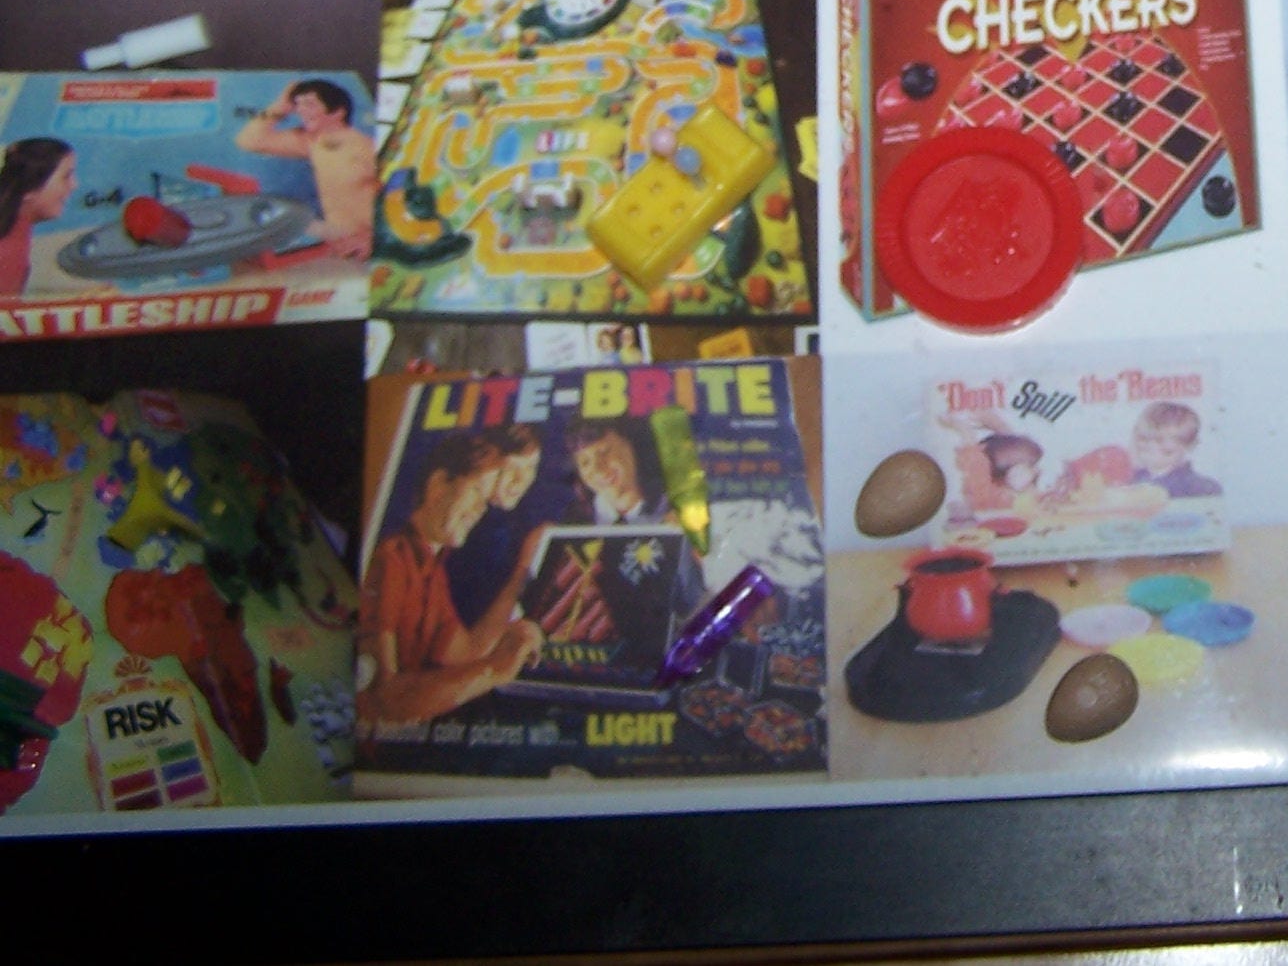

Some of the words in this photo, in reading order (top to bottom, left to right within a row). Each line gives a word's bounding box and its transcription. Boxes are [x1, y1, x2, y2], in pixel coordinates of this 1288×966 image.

[422, 364, 778, 431] LITE-BRITE
[1011, 380, 1077, 423] Spill
[1078, 375, 1117, 404] the
[1118, 369, 1204, 401] Beans
[103, 695, 182, 739] RISK
[584, 712, 678, 747] LIGHT
